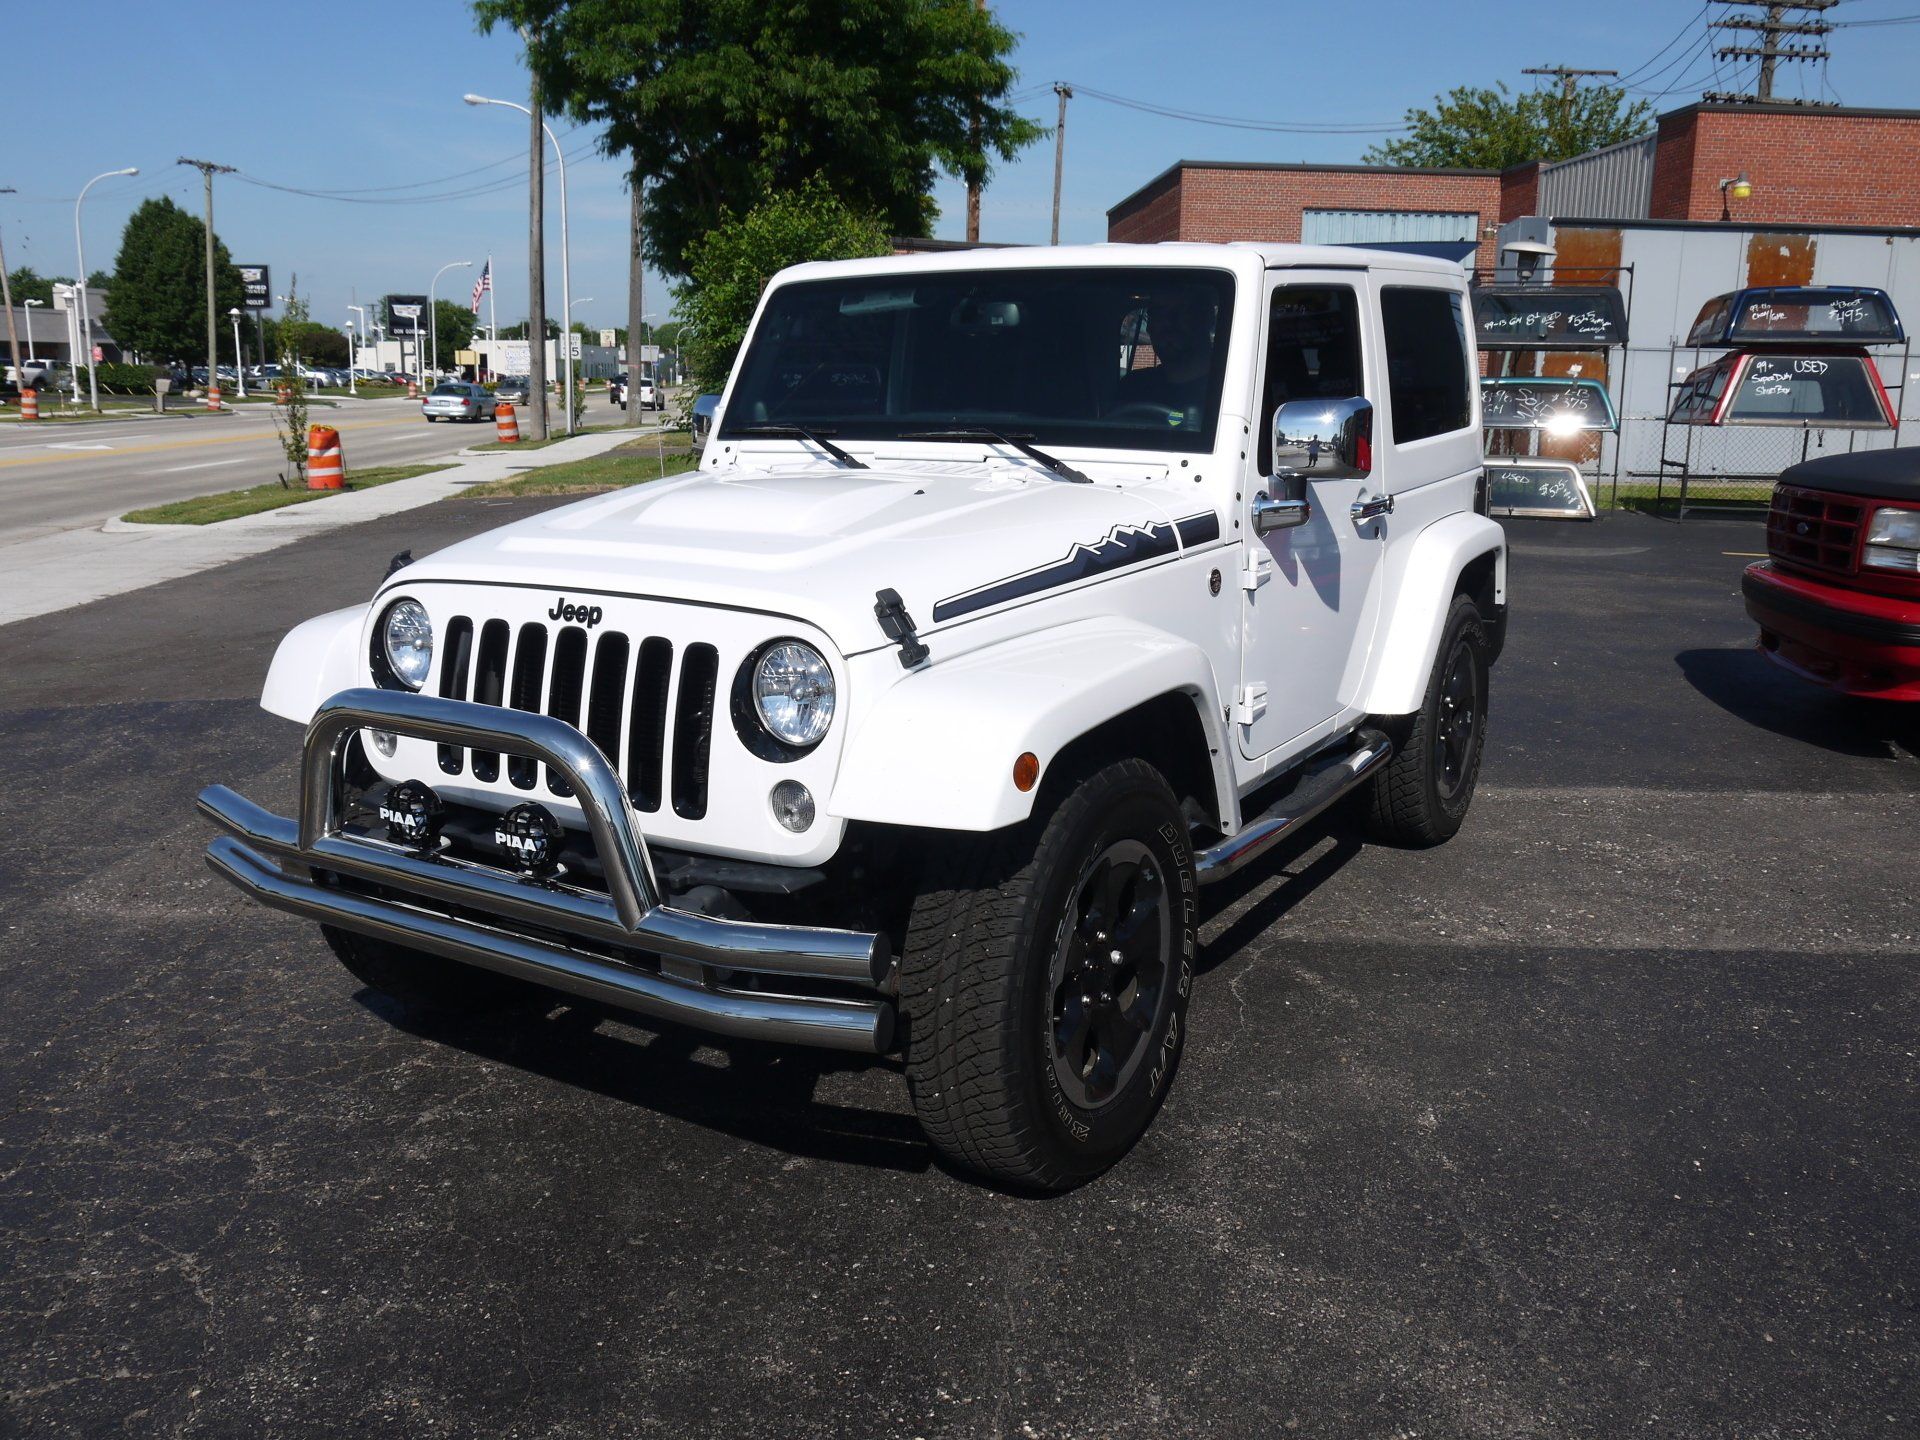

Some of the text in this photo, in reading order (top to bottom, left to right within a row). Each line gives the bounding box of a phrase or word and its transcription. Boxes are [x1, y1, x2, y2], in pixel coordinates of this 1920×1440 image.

[1794, 360, 1829, 375] USED
[548, 597, 603, 629] Jeep
[379, 807, 416, 827] PIAA
[495, 831, 537, 852] PIAA
[1150, 822, 1195, 1097] DUELER A/T
